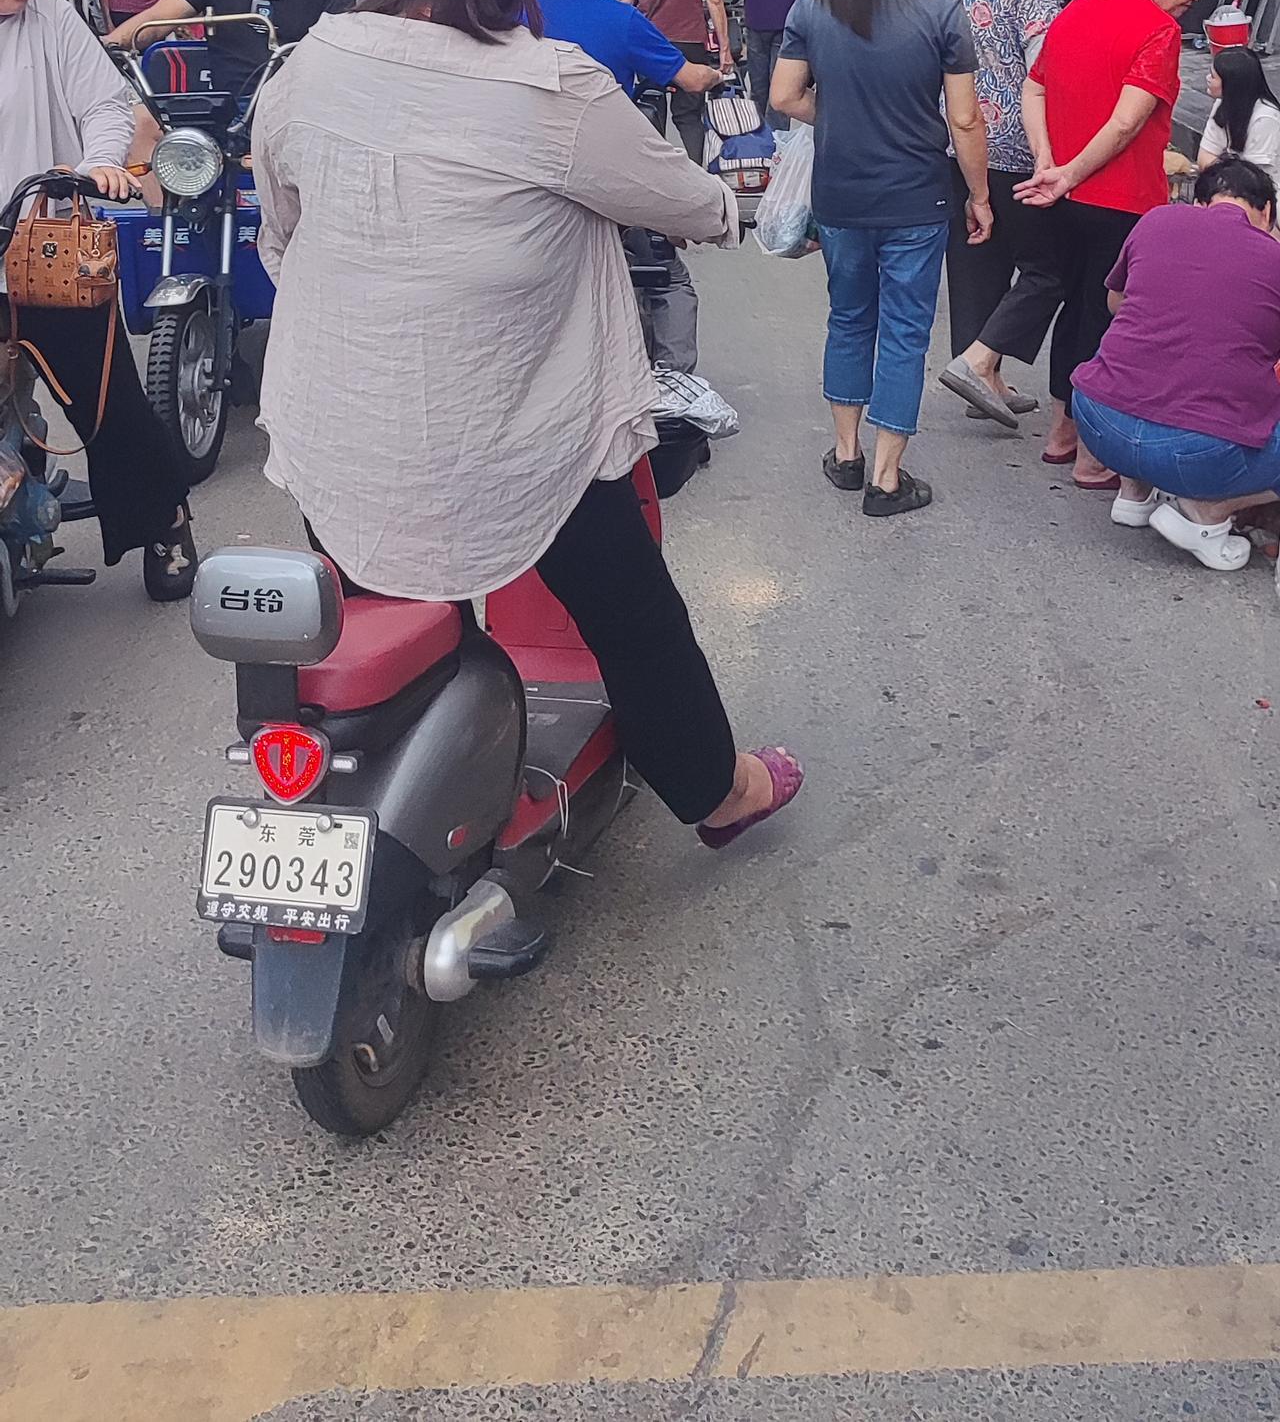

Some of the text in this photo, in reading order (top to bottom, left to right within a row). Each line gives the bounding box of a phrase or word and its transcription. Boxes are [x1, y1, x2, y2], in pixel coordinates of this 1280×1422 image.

[220, 585, 285, 614] 台铃
[258, 823, 316, 848] 东莞
[213, 849, 354, 898] 290343
[282, 907, 351, 931] 平安出行
